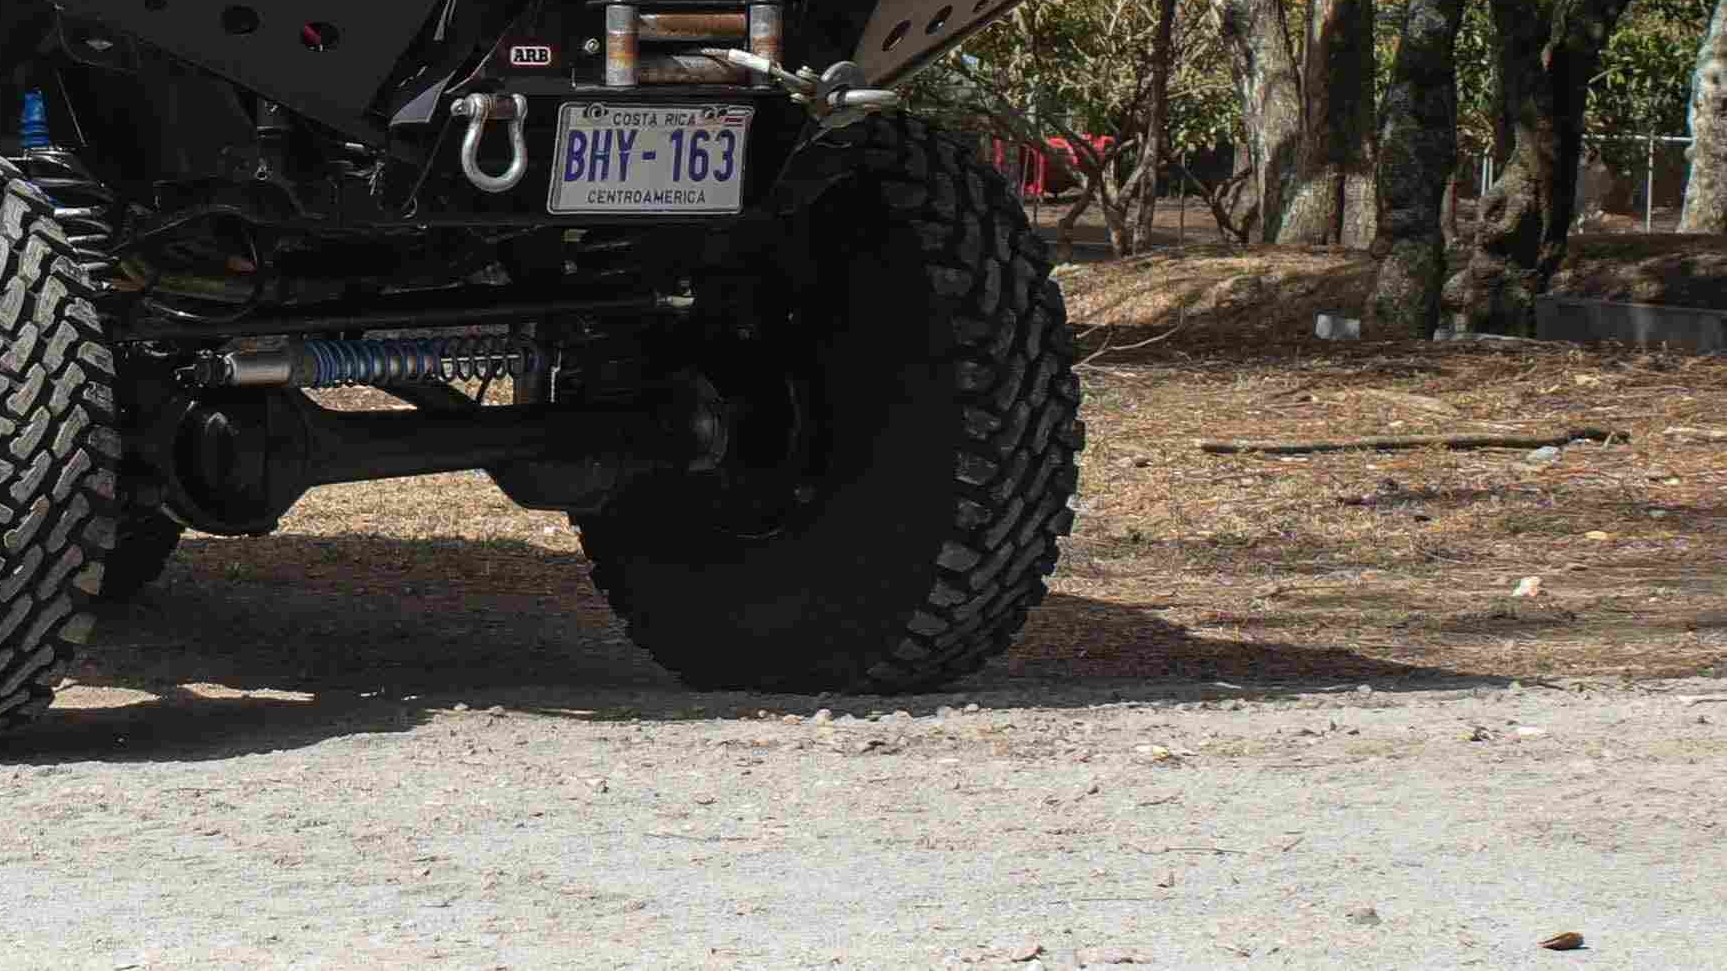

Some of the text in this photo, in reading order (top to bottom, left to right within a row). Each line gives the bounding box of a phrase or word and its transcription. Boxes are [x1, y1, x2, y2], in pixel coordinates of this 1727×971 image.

[513, 47, 549, 63] ARB
[613, 112, 696, 126] COSTA RICA
[587, 190, 706, 204] CENTROAMERICA
